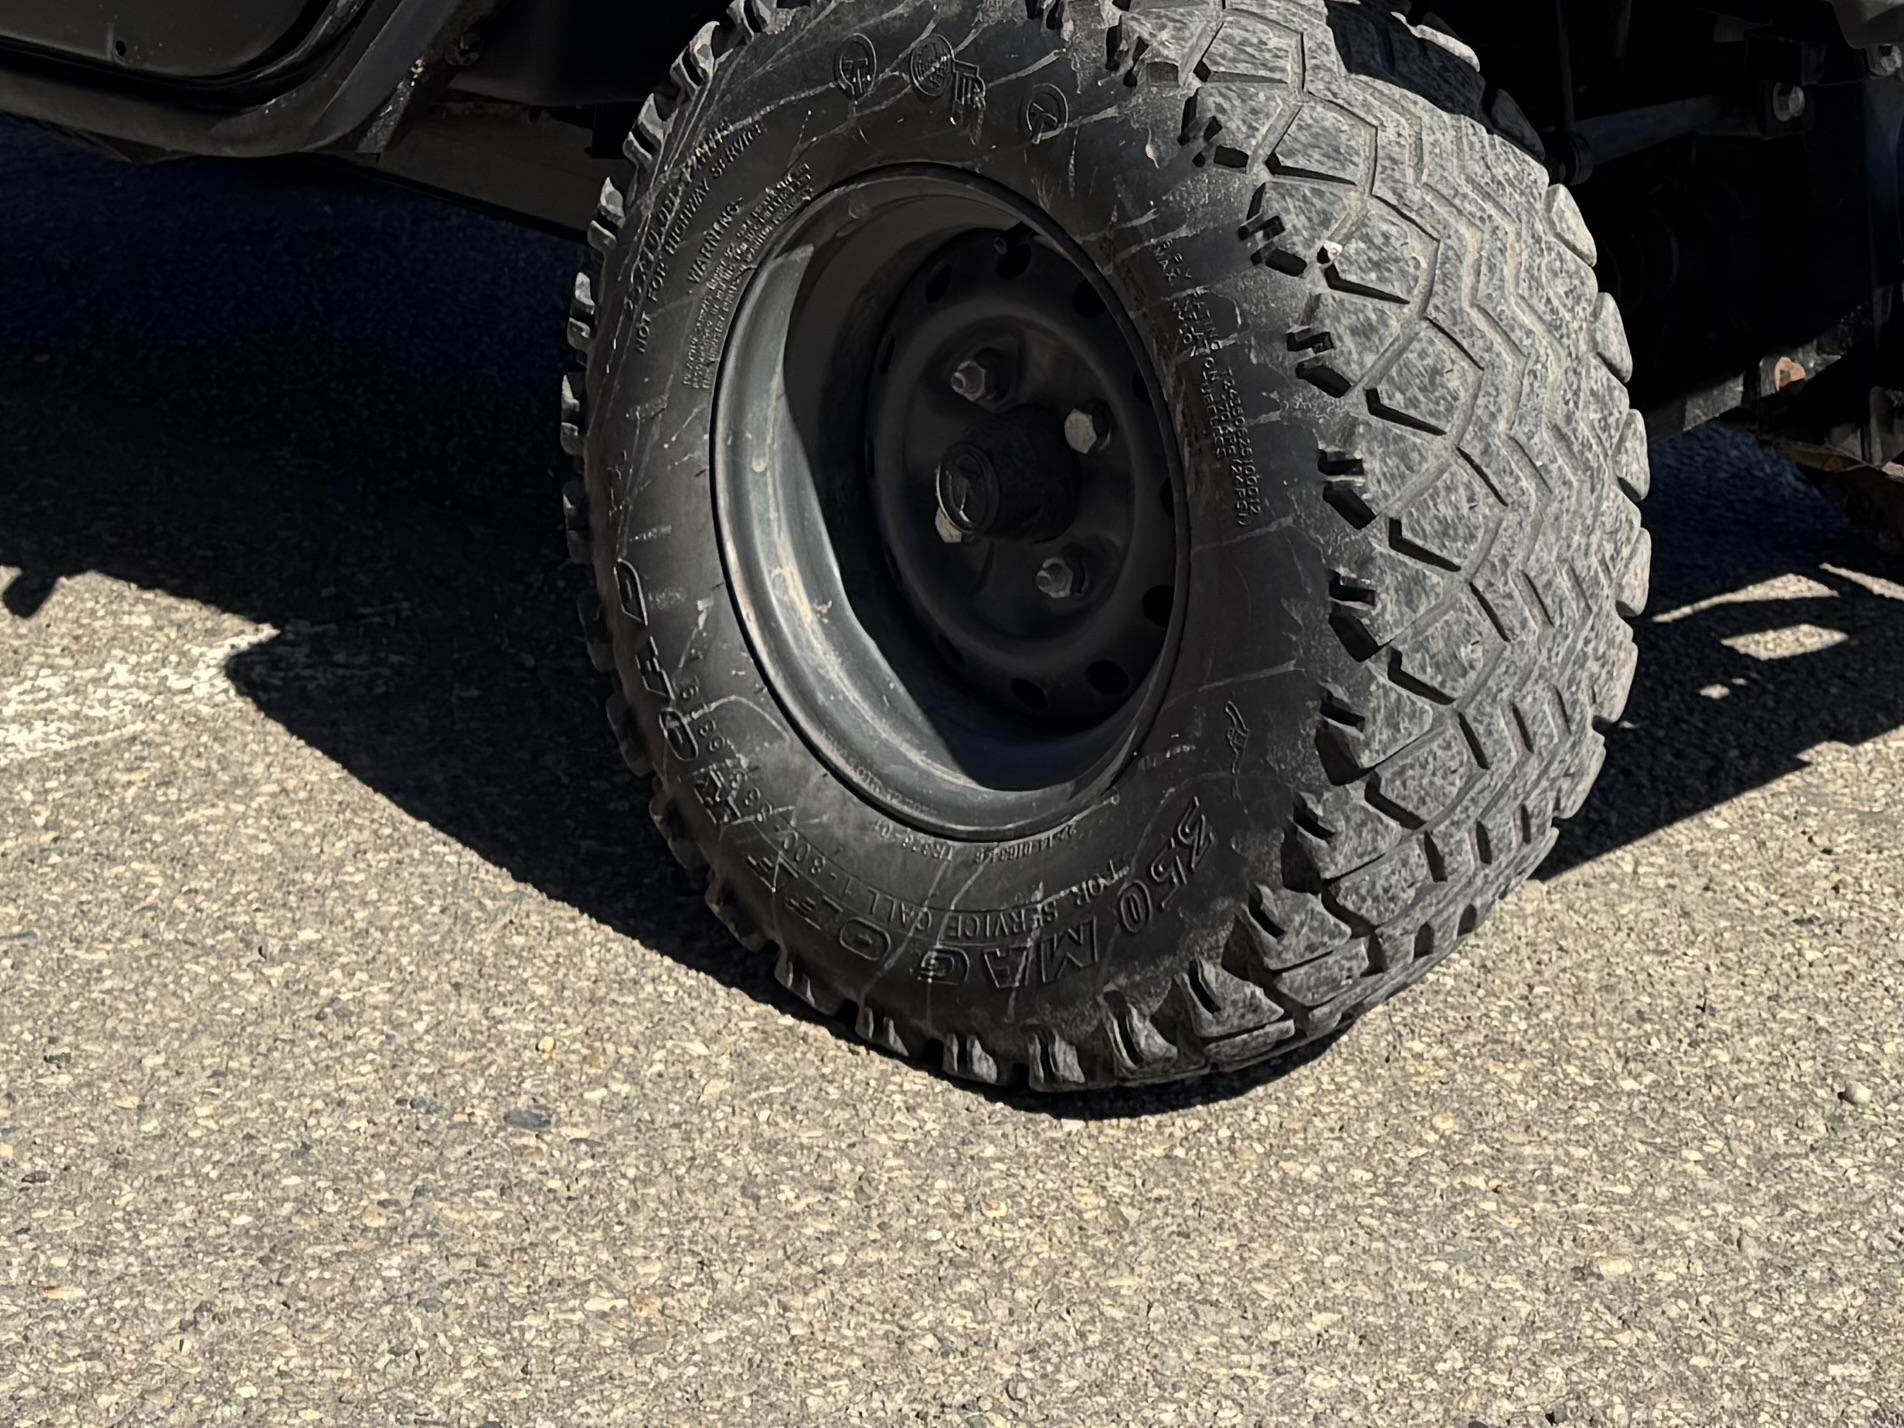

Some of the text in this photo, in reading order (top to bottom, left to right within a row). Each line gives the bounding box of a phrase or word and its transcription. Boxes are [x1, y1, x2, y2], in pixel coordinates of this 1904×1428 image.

[634, 309, 652, 354] NOT
[647, 260, 667, 302] FOR
[666, 177, 711, 254] HIGHWAY
[1118, 796, 1216, 935] 350
[865, 890, 932, 931] CALL
[946, 901, 1058, 941] SERVICE
[918, 916, 1099, 988] MAG
